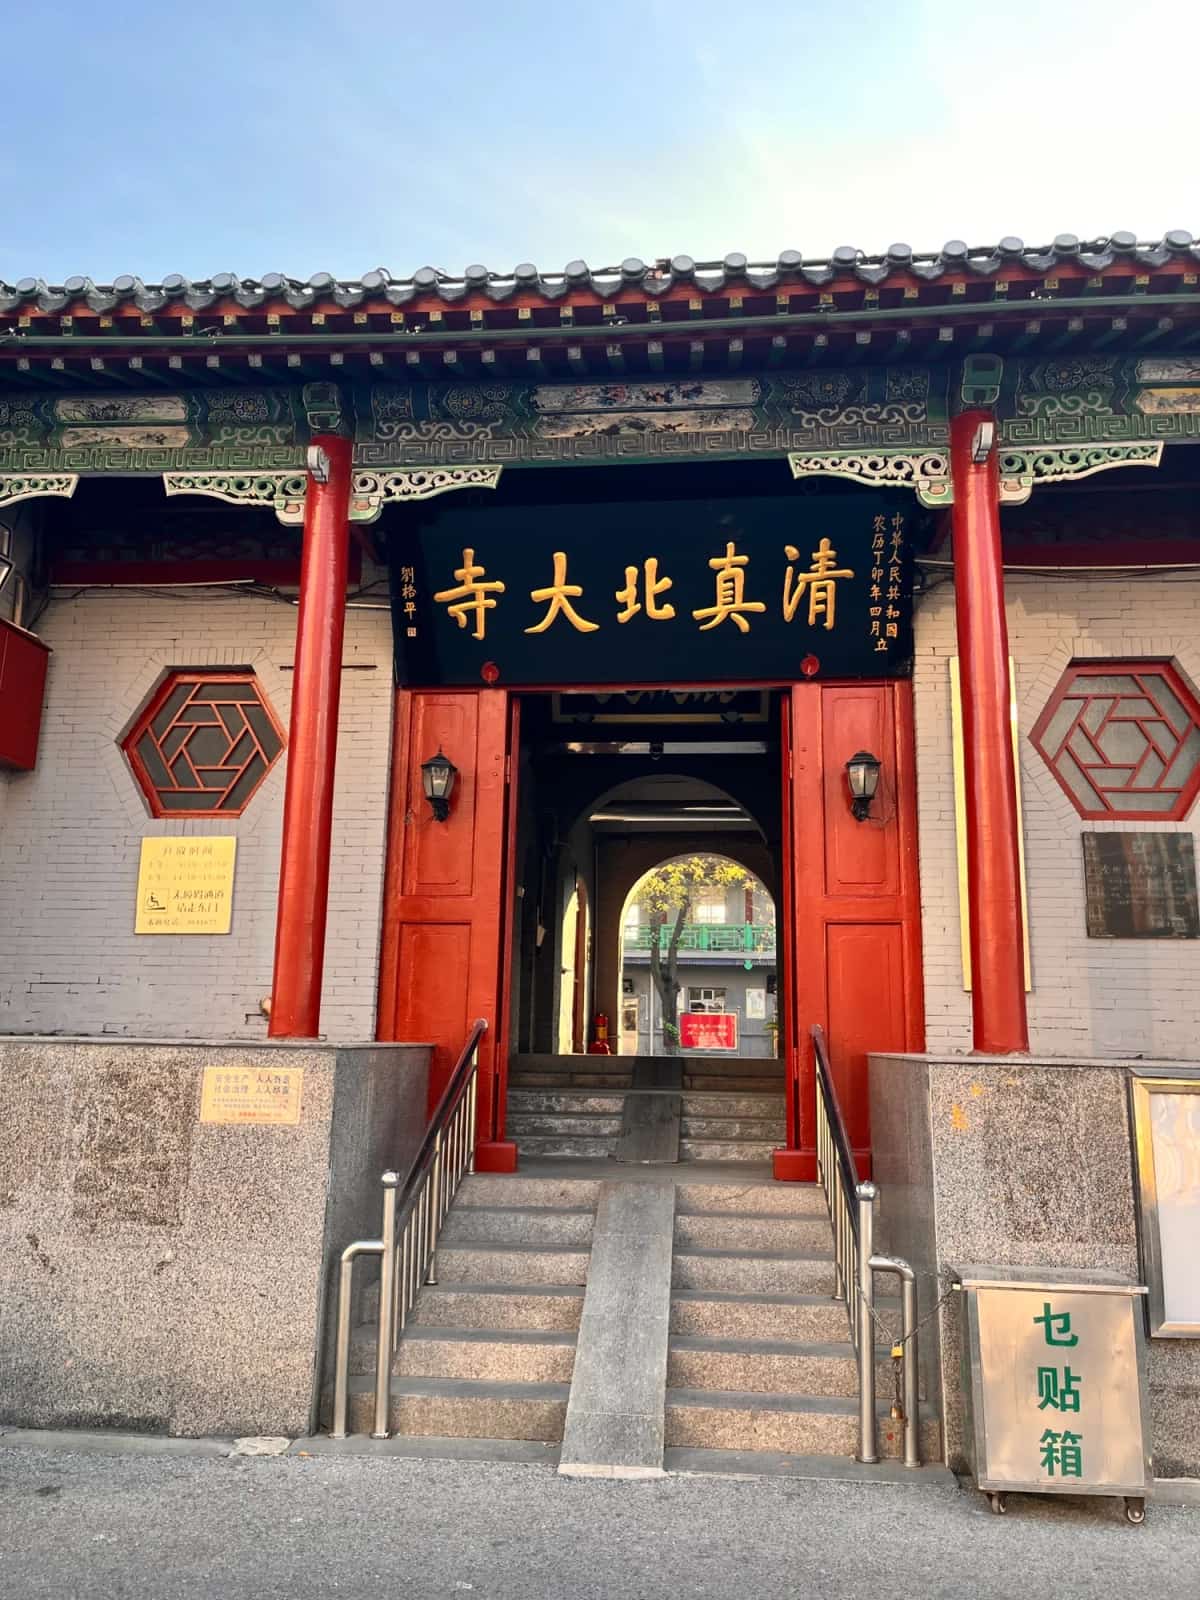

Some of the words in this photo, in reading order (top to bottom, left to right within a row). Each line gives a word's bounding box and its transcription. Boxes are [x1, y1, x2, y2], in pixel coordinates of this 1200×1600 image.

[433, 537, 855, 641] 清真北大寺
[1033, 1302, 1084, 1478] 乜贴箱
